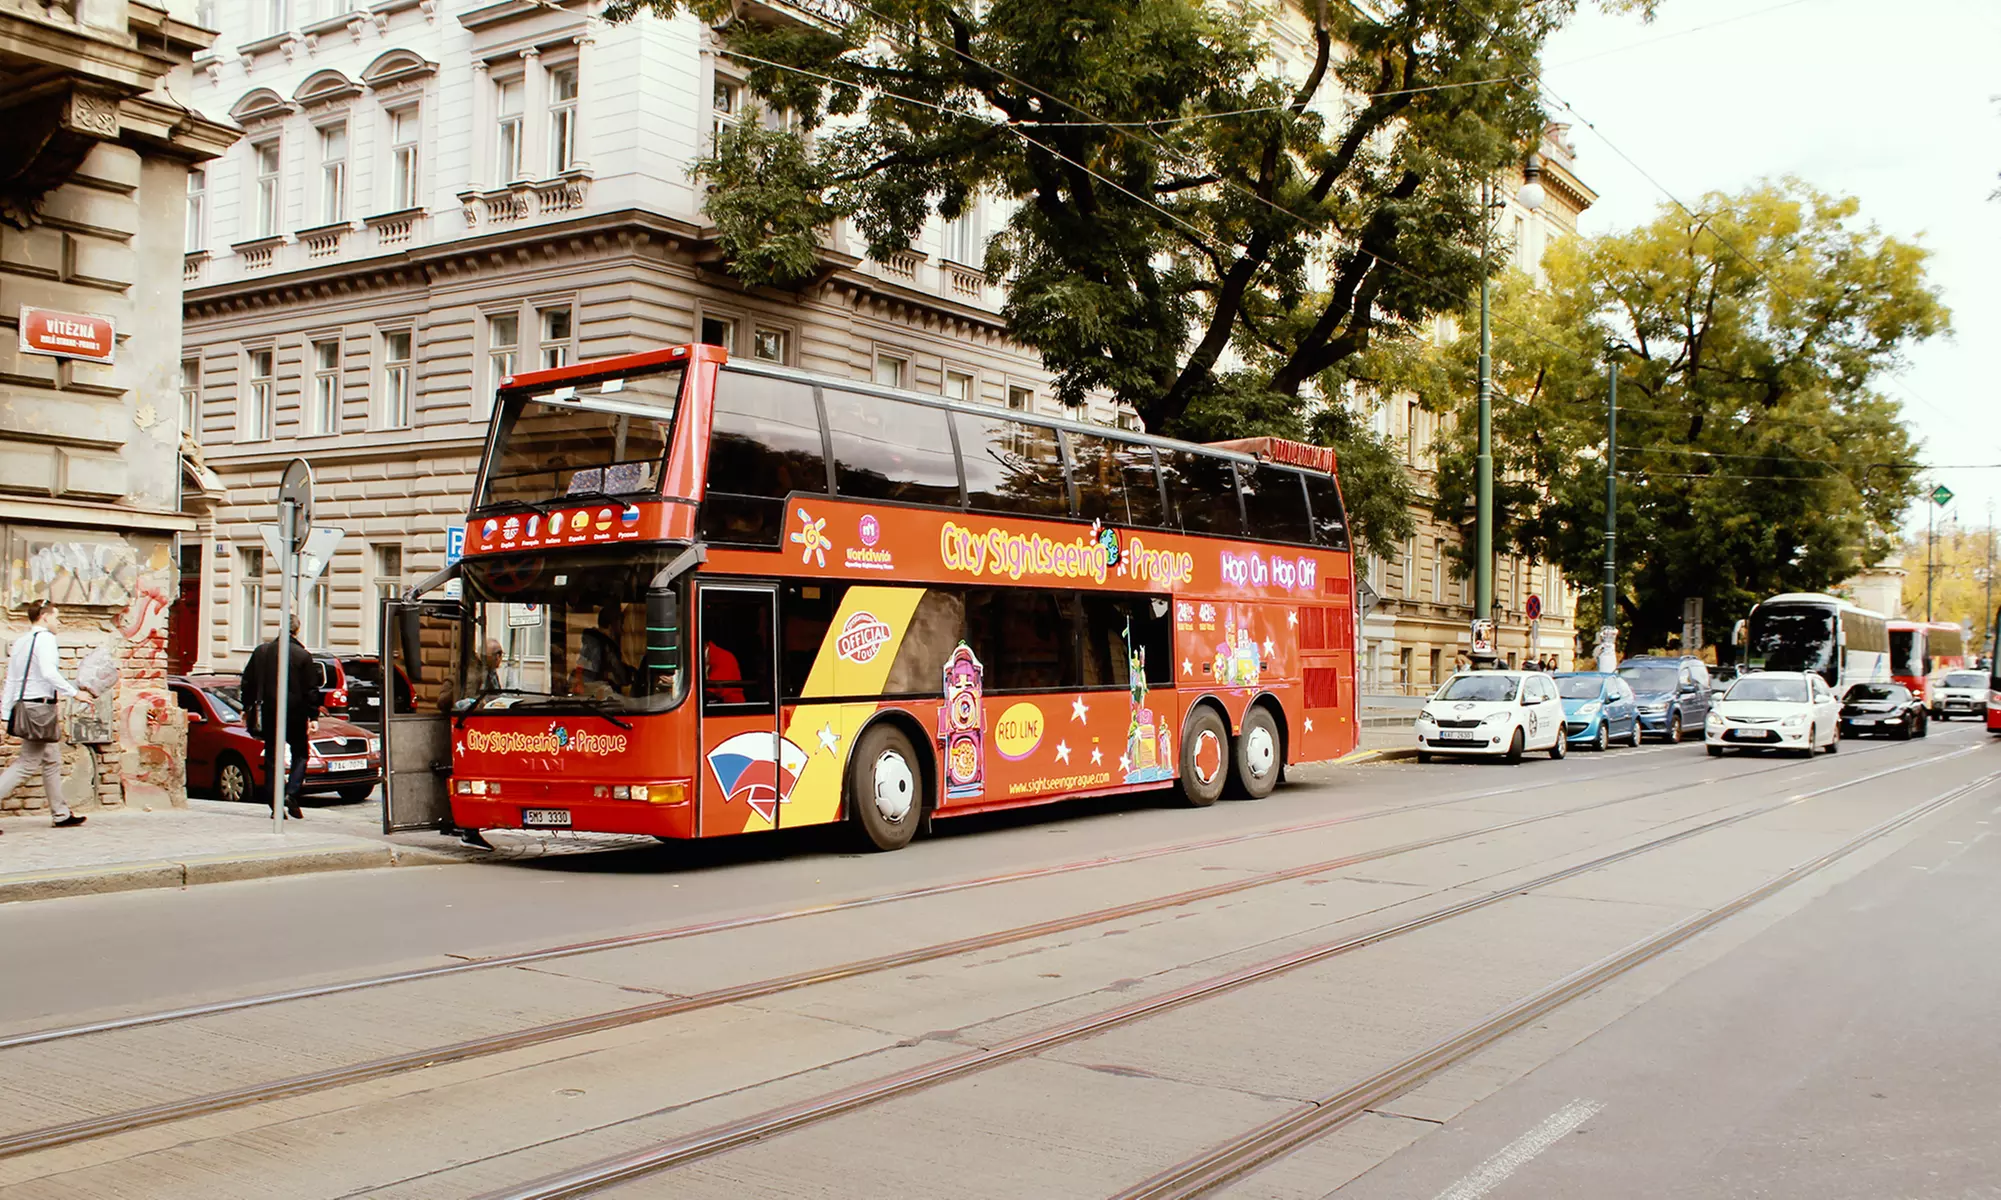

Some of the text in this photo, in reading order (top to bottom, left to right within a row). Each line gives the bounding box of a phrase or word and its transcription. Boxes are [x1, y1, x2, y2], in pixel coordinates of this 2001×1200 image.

[1129, 536, 1194, 588] Prague
[1222, 553, 1316, 589] Hop On Hop Off
[841, 625, 888, 654] OFFICIAL
[856, 644, 877, 660] TOUR
[999, 720, 1039, 740] RED LINE
[576, 729, 627, 756] Prague
[1009, 772, 1110, 794] www.sightseeingprague.com
[528, 811, 569, 824] 5M3 3330
